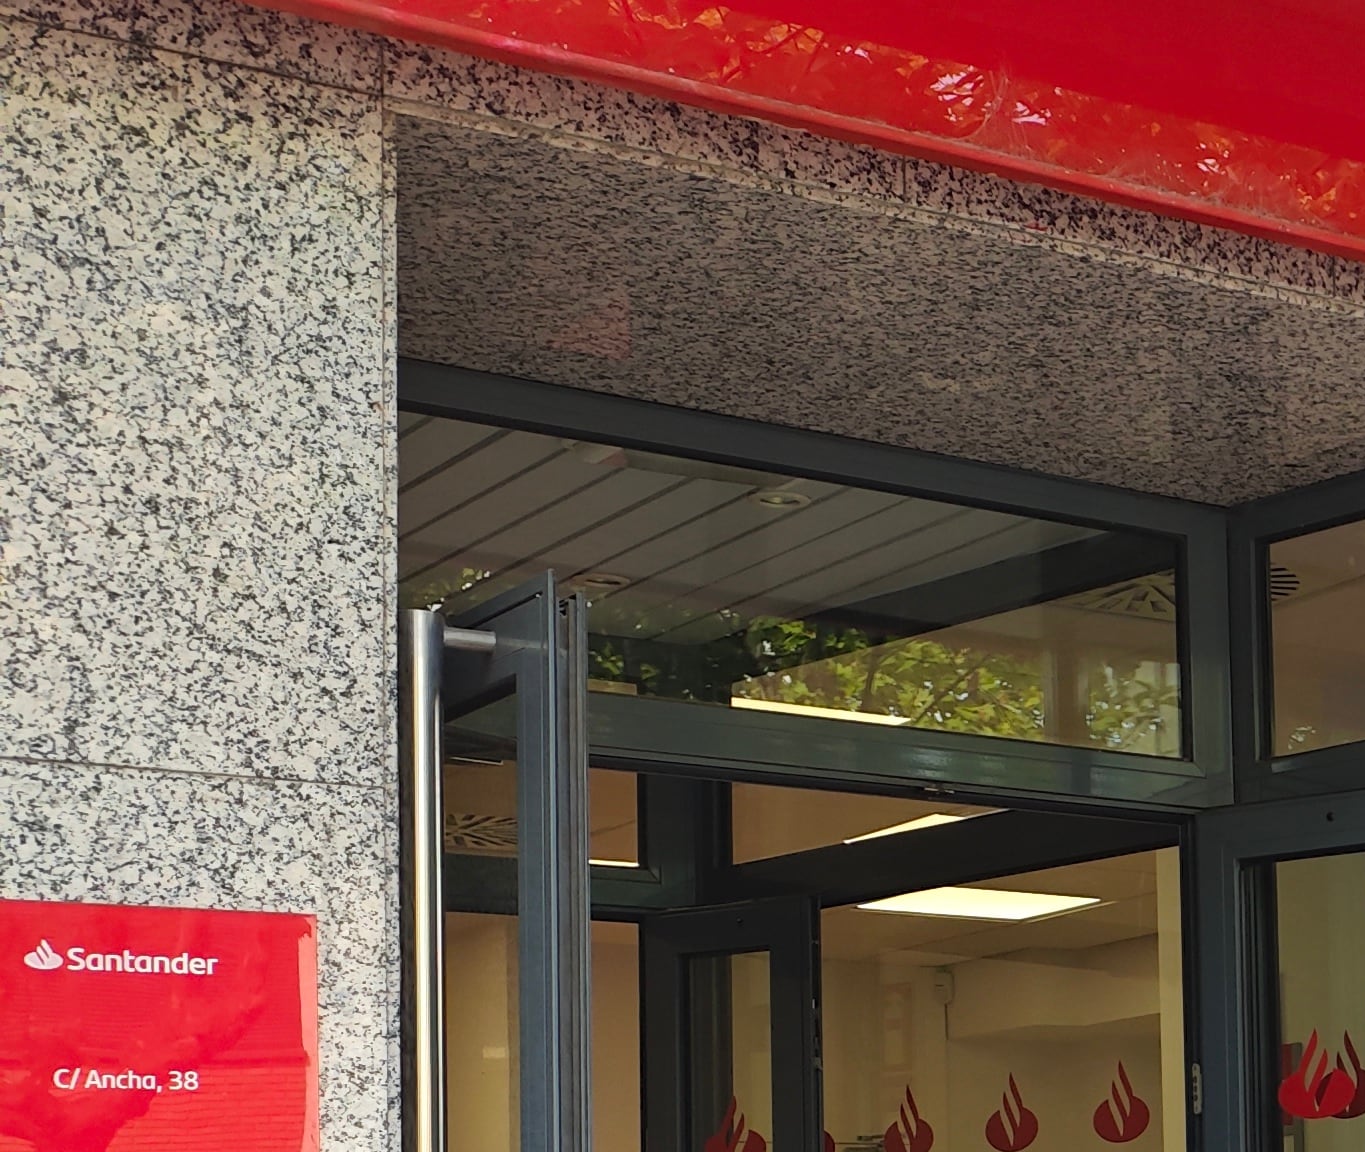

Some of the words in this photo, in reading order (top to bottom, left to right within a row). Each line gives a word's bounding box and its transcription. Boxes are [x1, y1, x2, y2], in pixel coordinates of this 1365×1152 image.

[66, 947, 219, 976] Santander
[52, 1068, 79, 1090] C/
[84, 1069, 164, 1094] Ancha,
[168, 1070, 200, 1091] 38
